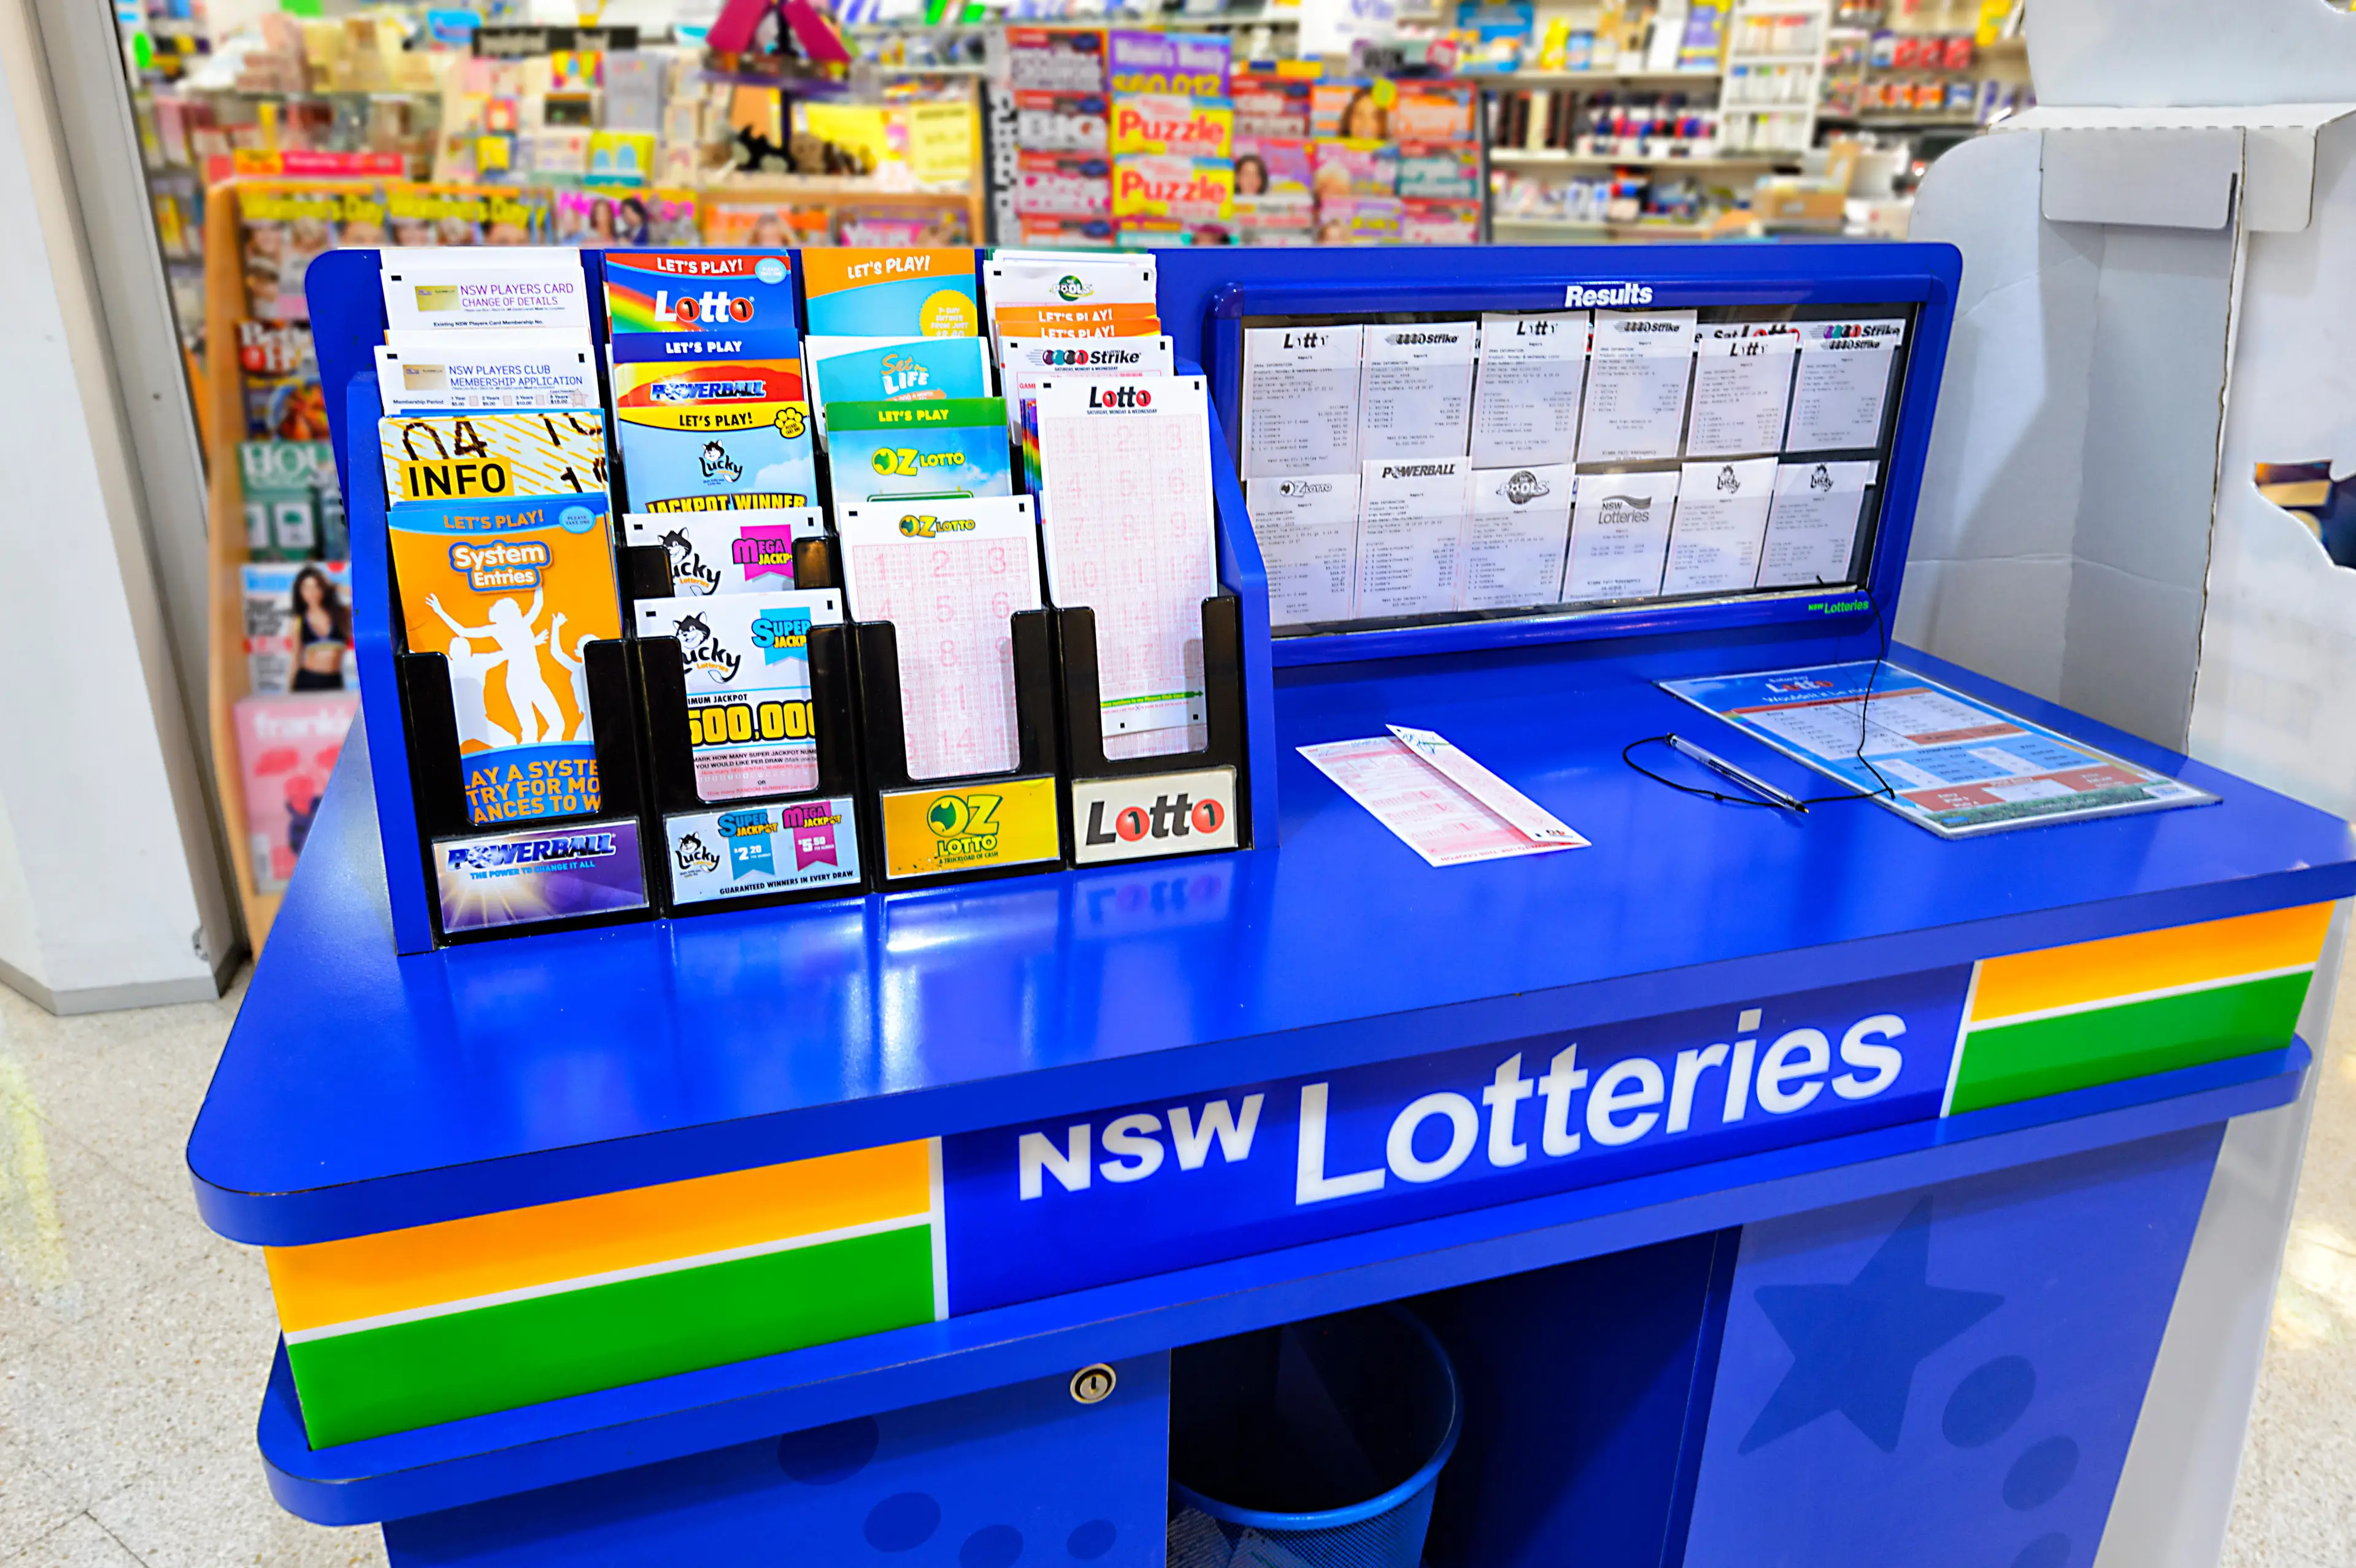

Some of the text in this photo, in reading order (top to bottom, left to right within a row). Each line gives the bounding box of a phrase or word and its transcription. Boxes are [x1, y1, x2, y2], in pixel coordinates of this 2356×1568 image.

[1119, 110, 1225, 145] Puzzle
[1121, 171, 1226, 204] Puzzle
[656, 258, 743, 274] LET'S PLAY!
[848, 256, 930, 279] LET'S PLAY!
[461, 285, 488, 296] NSW
[491, 284, 541, 295] PLAYERS
[544, 283, 574, 294] CARD
[1565, 283, 1653, 307] Results
[463, 296, 558, 307] CHANGE OF DETAILS
[655, 291, 755, 323] Lotto
[1650, 323, 1680, 332] Strike
[1862, 325, 1900, 337] Strike
[666, 341, 742, 354] LET'S PLAY
[1090, 350, 1139, 364] Strike
[449, 365, 551, 375] NSW PLAYERS CLUB
[881, 353, 913, 375] Set
[451, 376, 582, 386] MEMBERSHIP APPLICATION
[650, 380, 766, 401] POWERBALL
[882, 371, 929, 394] LIFE
[1089, 386, 1152, 408] Lotto
[679, 412, 753, 427] LET'S PLAY!
[879, 409, 949, 422] LET'S PLAY
[699, 455, 743, 482] Lucky
[872, 447, 965, 476] OZ LOTTO
[1382, 464, 1456, 478] POWERBALL
[409, 463, 506, 497] INFO
[443, 510, 545, 529] LET'S PLAY!
[899, 515, 976, 538] OZ LOTTO
[1598, 510, 1649, 525] Lotteries
[453, 545, 545, 571] System
[732, 538, 785, 564] MEGA
[474, 570, 534, 586] Entries
[679, 577, 710, 588] Lotteries
[1825, 599, 1869, 614] Lotteries
[696, 662, 729, 672] Lotteries
[713, 693, 748, 703] JACKPOT
[507, 764, 524, 781] A
[519, 778, 563, 796] FOR
[553, 795, 577, 812] TO
[717, 813, 768, 838] SUPER
[782, 806, 826, 828] MEGA
[804, 815, 842, 828] JACKPOT
[927, 794, 1003, 838] OZ
[1086, 793, 1225, 846] Lotto
[736, 823, 778, 837] JACKPOT
[446, 833, 617, 871] POWERBALL
[937, 835, 998, 856] LOTTO
[675, 846, 720, 872] Lucky
[470, 872, 487, 880] THE
[489, 868, 520, 878] POWER
[534, 864, 568, 874] CHANGE
[720, 883, 764, 894] GUARANTEED
[767, 878, 798, 888] WINNERS
[810, 873, 830, 882] EVERY
[833, 870, 853, 879] DRAW
[1018, 1009, 1907, 1205] NSW Lotteries
